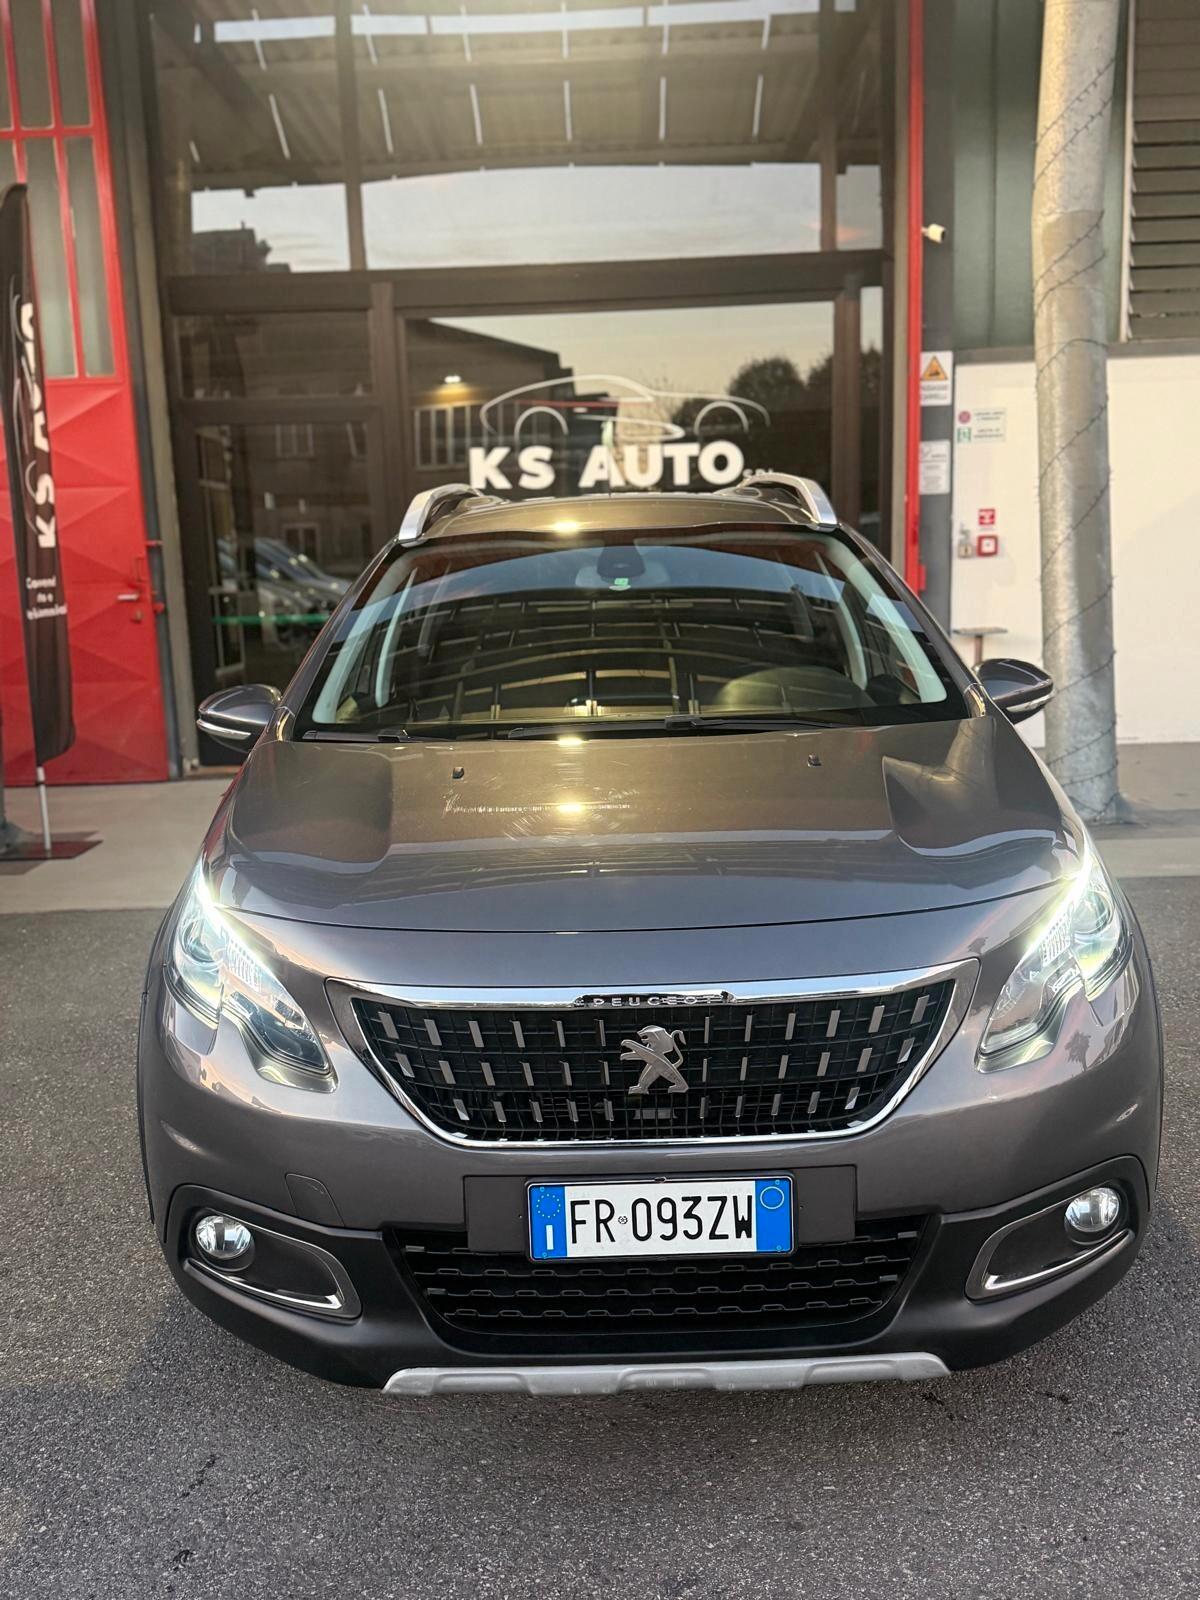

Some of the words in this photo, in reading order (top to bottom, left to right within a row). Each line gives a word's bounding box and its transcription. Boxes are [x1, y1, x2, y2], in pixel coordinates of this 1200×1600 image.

[470, 446, 555, 489] KS
[578, 440, 745, 488] AUTO
[593, 994, 717, 1007] PEUGEOT
[570, 1199, 616, 1244] FR
[631, 1195, 753, 1241] 093ZW
